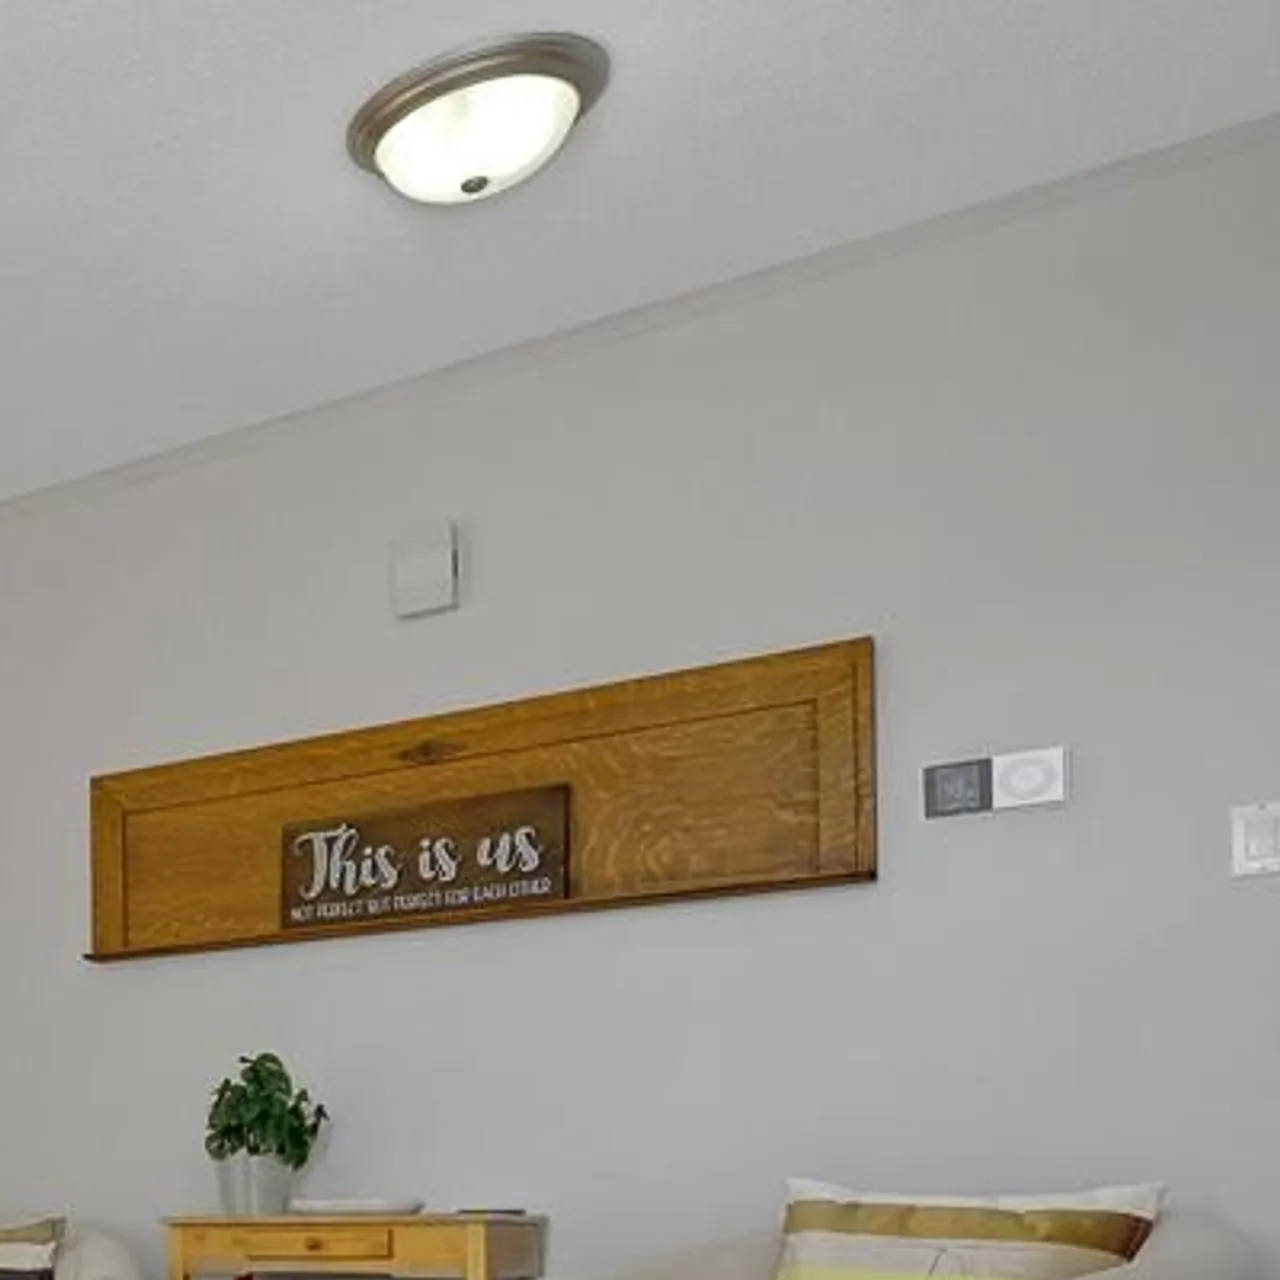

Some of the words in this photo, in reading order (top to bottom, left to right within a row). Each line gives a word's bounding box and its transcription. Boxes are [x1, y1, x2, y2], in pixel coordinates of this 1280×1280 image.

[294, 823, 402, 899] This
[417, 837, 462, 882] is
[476, 826, 544, 873] us
